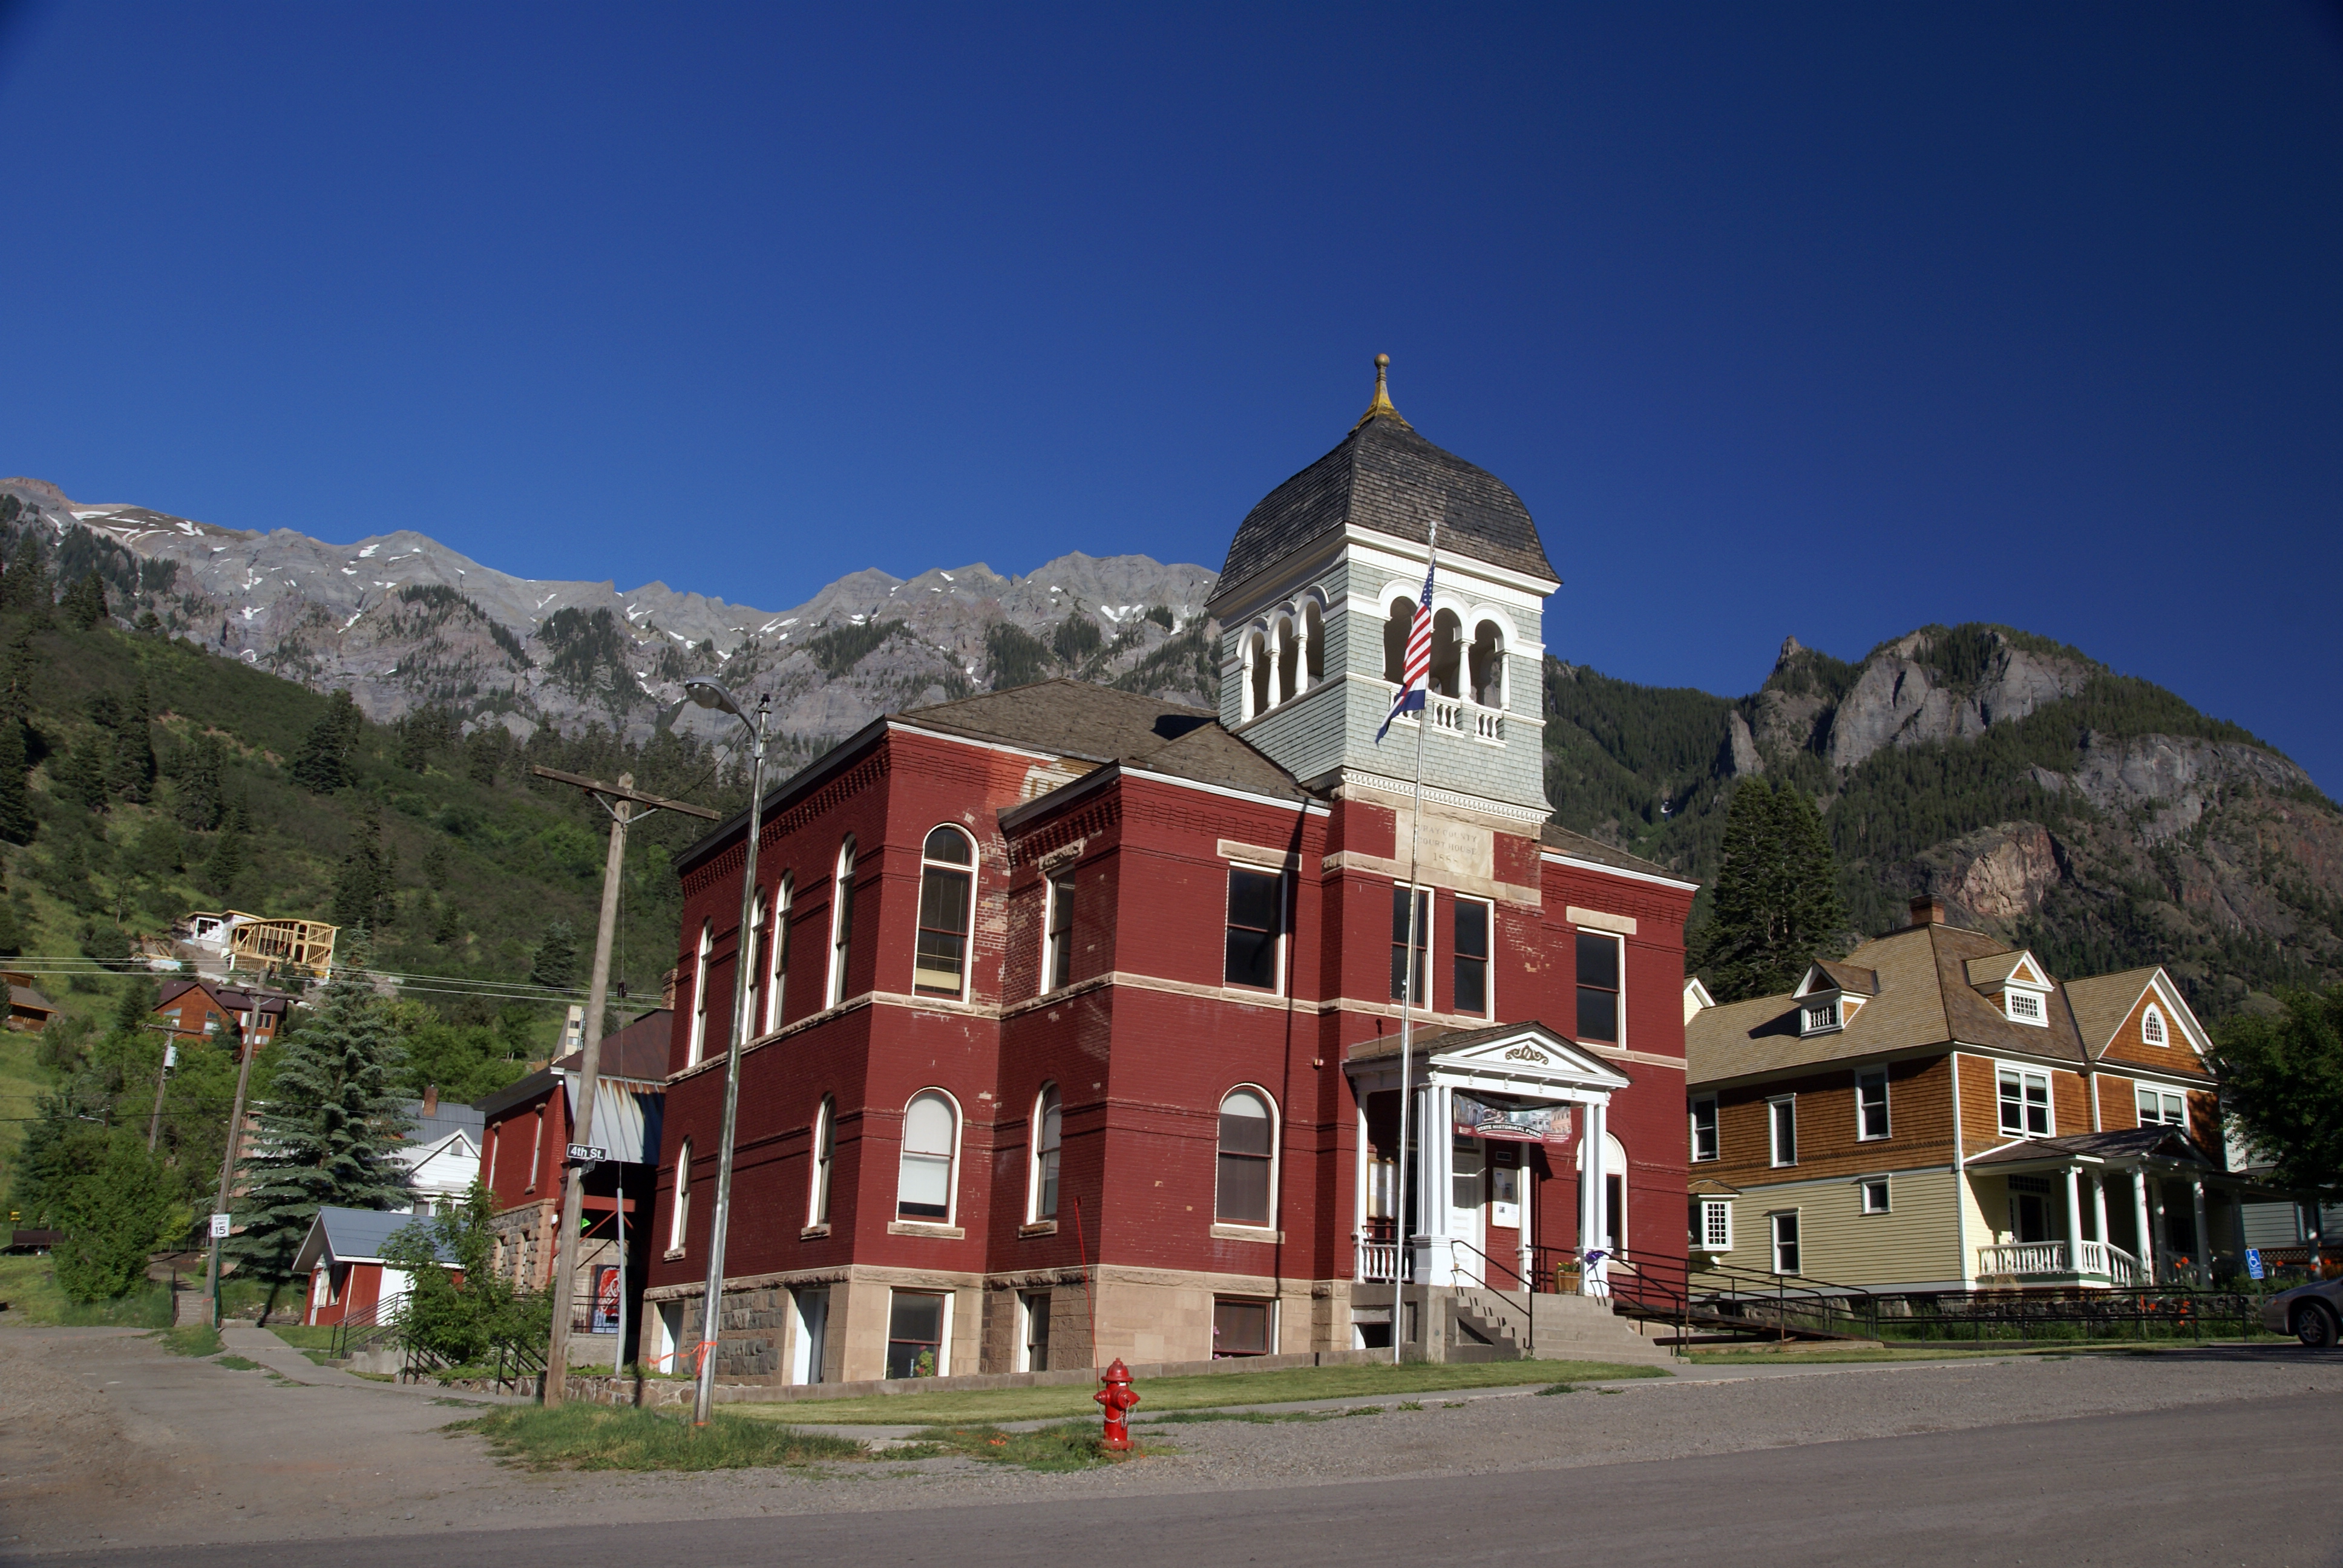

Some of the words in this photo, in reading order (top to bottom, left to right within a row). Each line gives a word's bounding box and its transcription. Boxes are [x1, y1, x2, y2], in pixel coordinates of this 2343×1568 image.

[1443, 829, 1476, 842] COUNTY
[1417, 837, 1446, 848] COURT
[1525, 1128, 1541, 1138] FUND
[571, 1146, 588, 1157] 4th
[590, 1148, 603, 1159] St.
